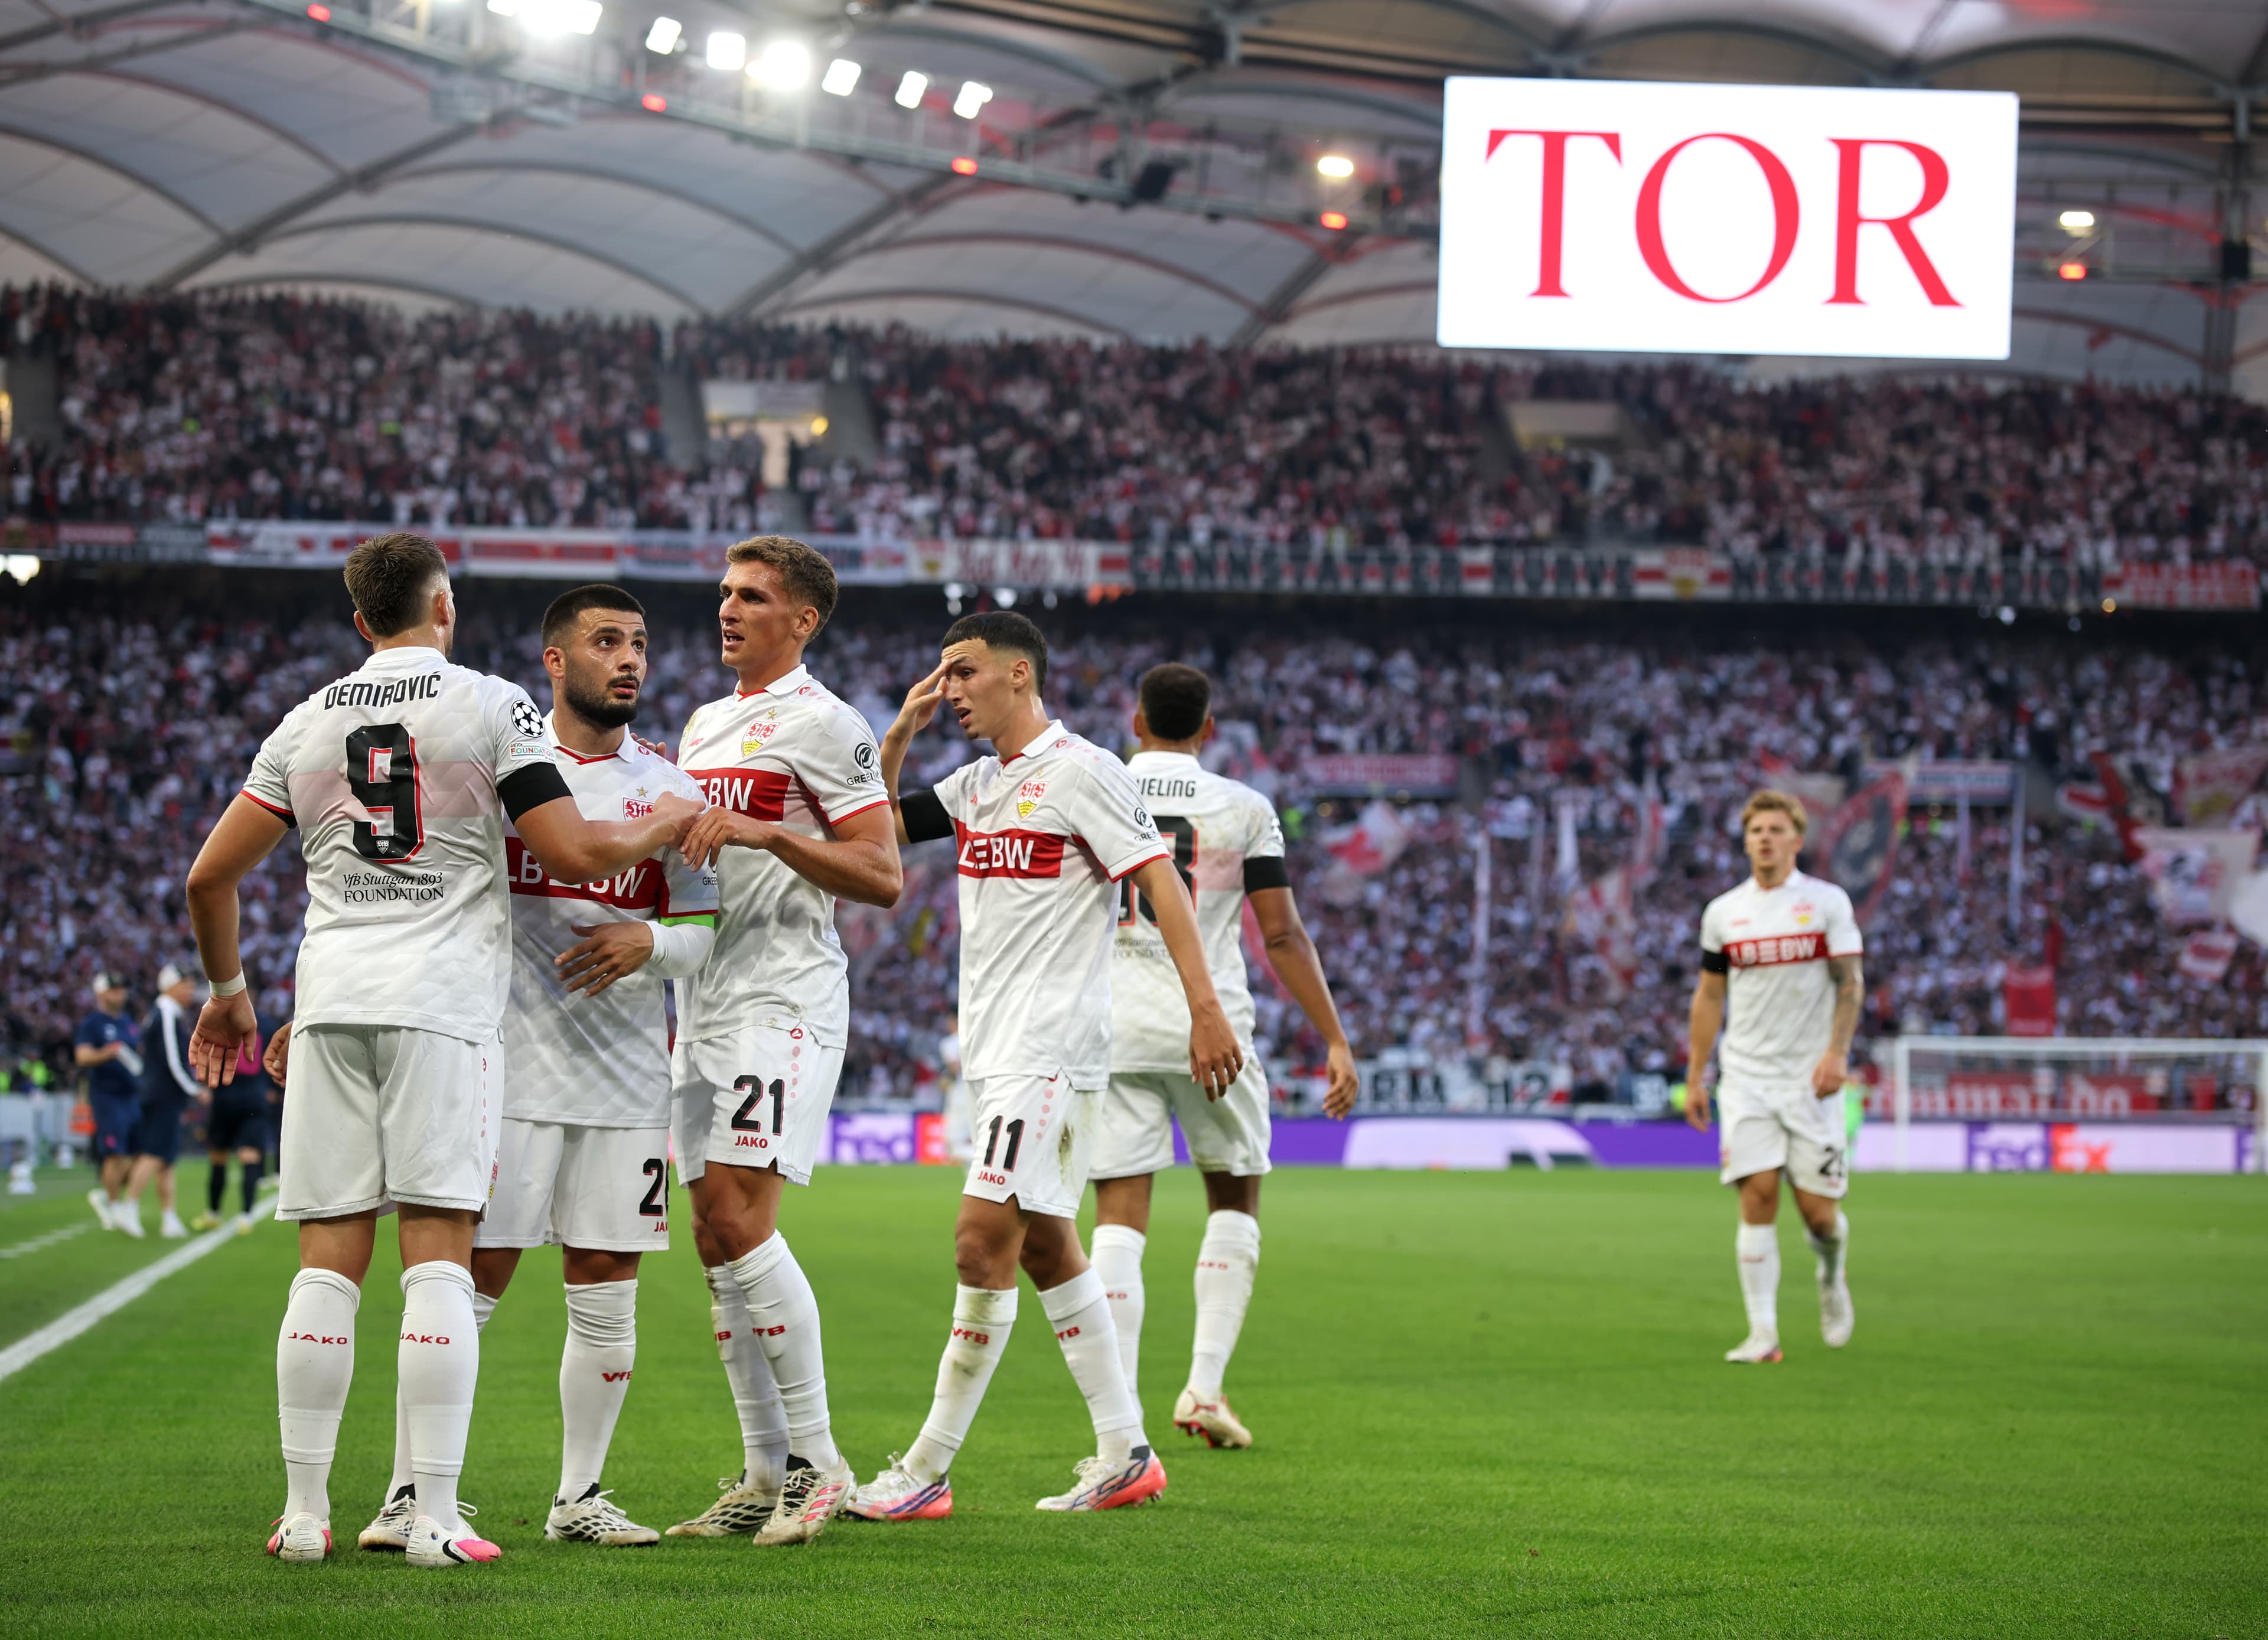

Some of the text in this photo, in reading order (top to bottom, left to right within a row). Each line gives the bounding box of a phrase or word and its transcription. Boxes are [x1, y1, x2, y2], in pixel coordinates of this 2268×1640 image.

[1484, 129, 1966, 308] TOR
[324, 671, 441, 710] DEMIROVIĆ
[511, 747, 554, 758] FOUNDATION
[346, 723, 424, 864] 9
[343, 871, 442, 888] VfB Stuttgart 1893
[344, 886, 444, 903] FOUNDATION
[731, 1074, 785, 1136] 21
[734, 1135, 768, 1148] JAKO
[983, 1115, 1025, 1173] 11
[1969, 1122, 2110, 1173] FedEx
[977, 1170, 1005, 1186] JAKO
[288, 1332, 348, 1345] JAKO
[953, 1327, 989, 1345] VfB
